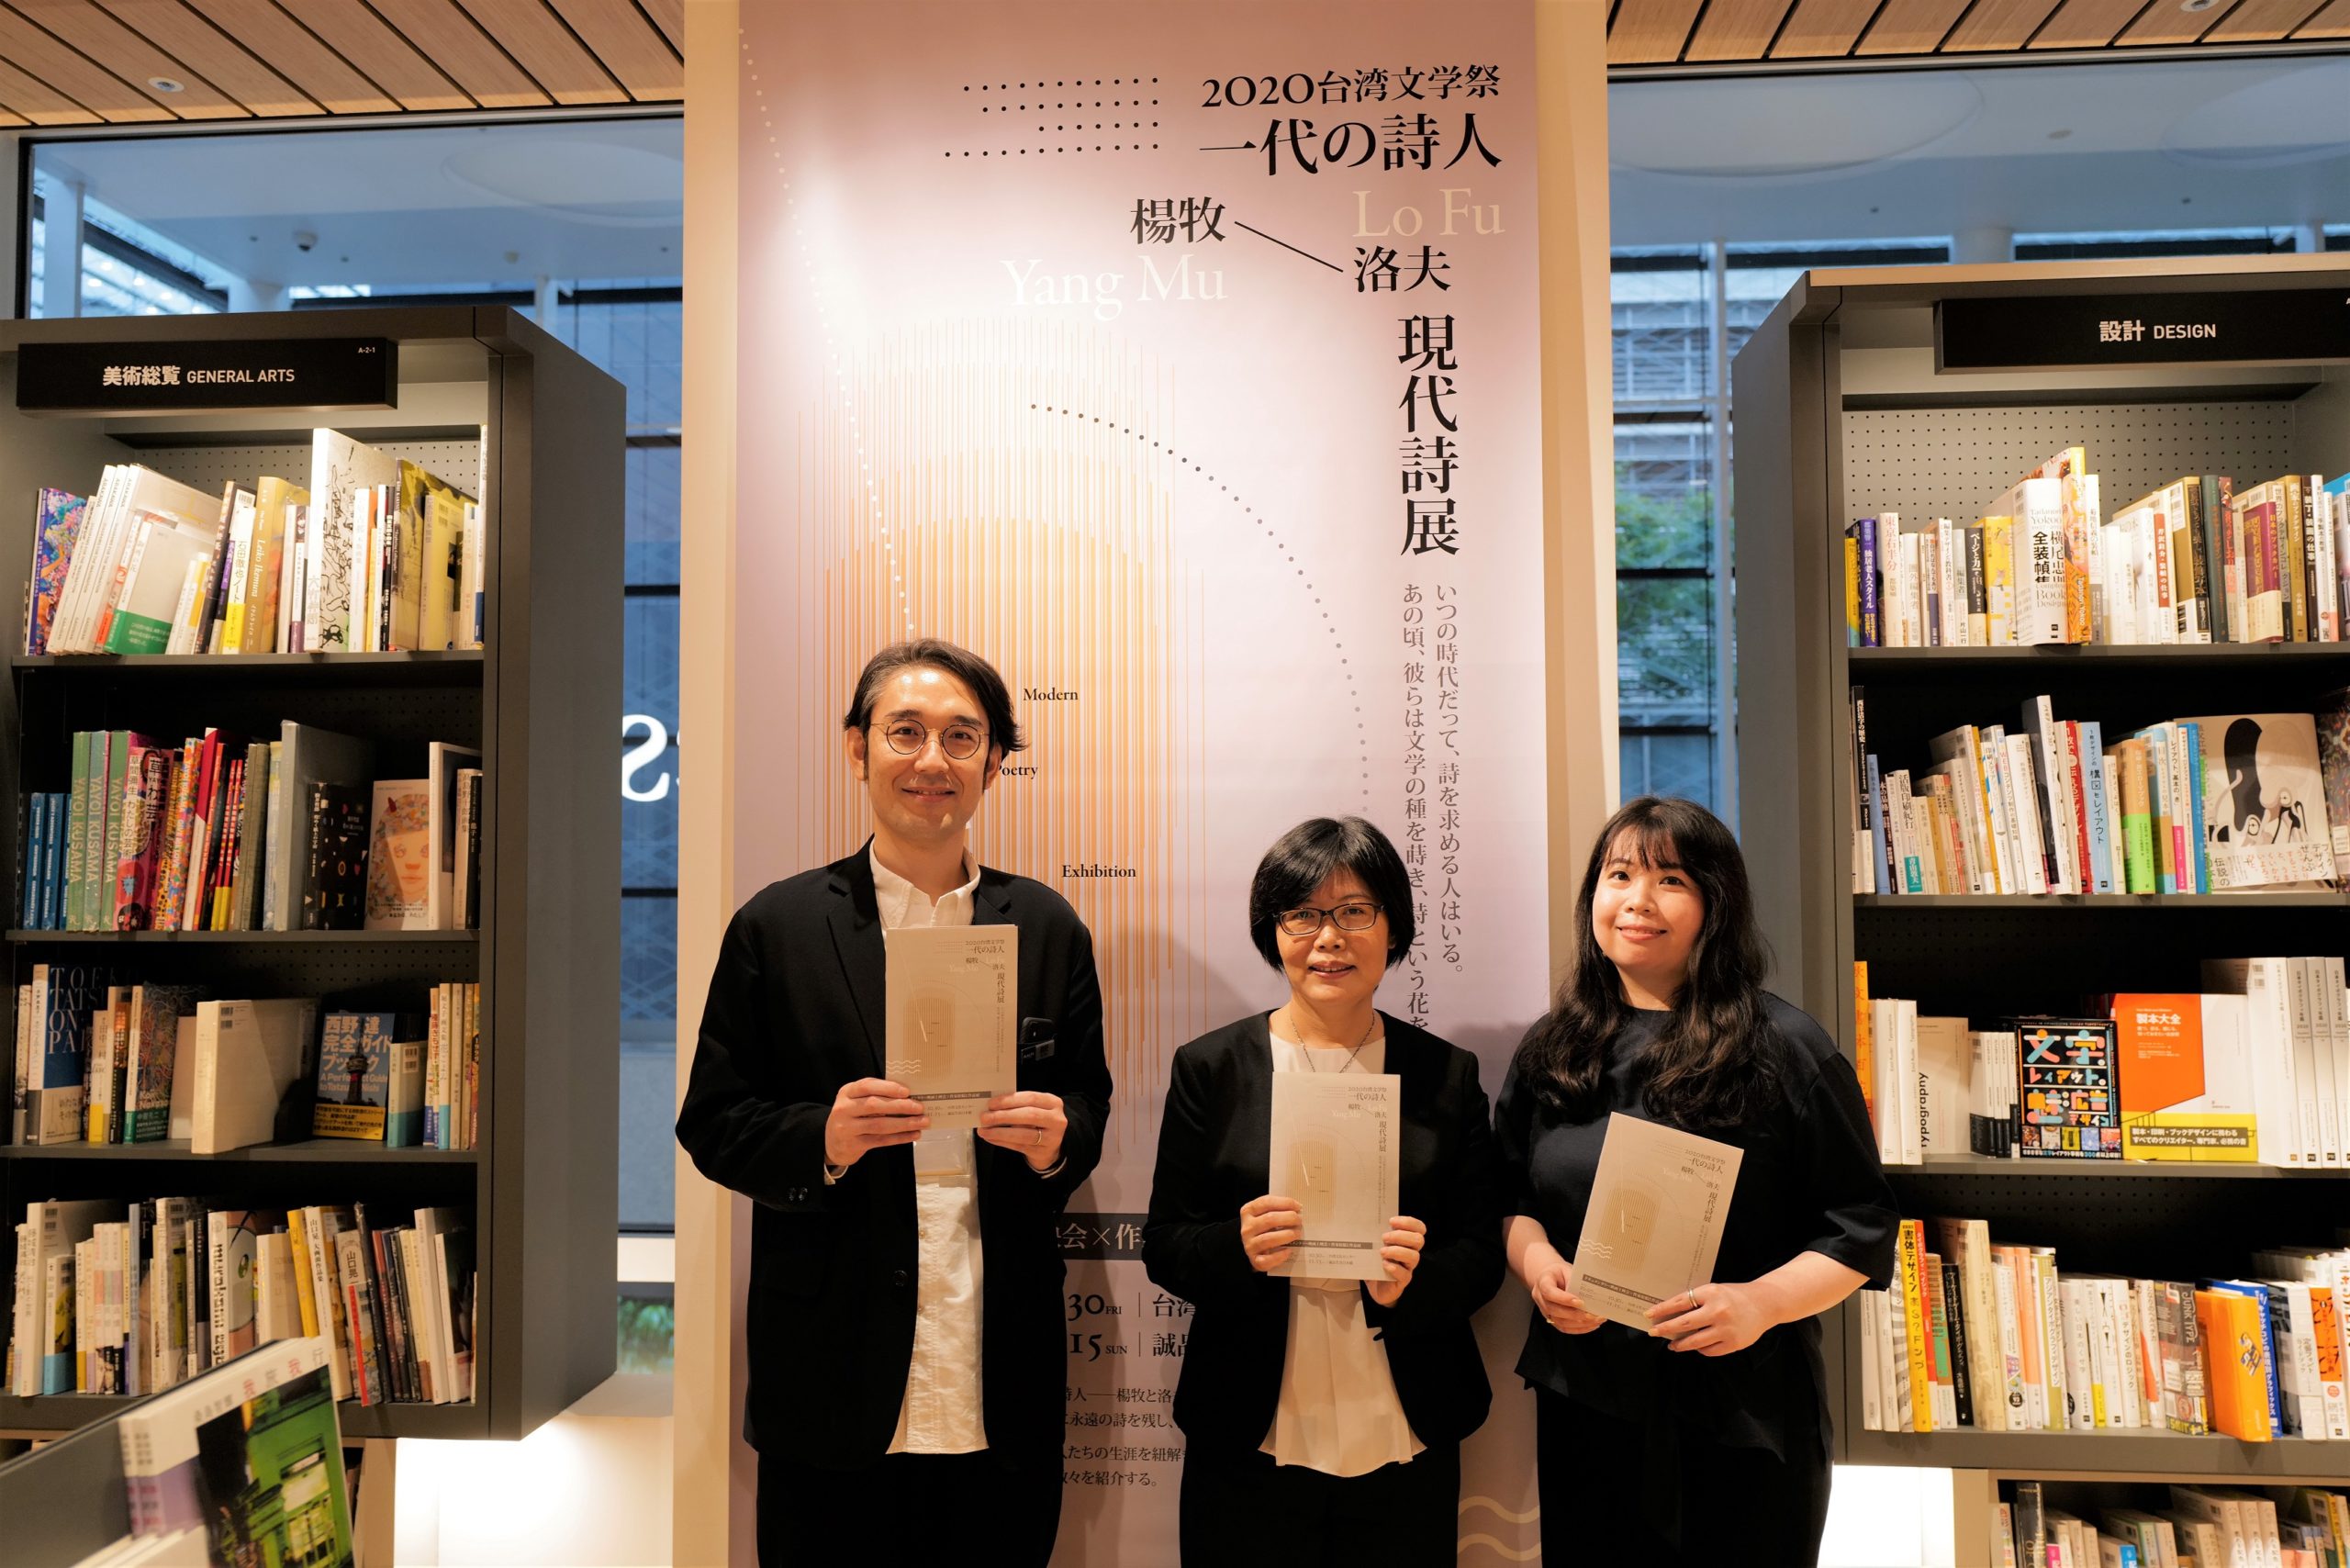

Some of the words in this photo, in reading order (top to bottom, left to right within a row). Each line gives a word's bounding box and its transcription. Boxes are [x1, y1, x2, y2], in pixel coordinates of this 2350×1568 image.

[1201, 64, 1500, 106] 2020台湾文学祭
[1200, 112, 1502, 175] 一代の詩人
[1130, 196, 1225, 244] 楊牧
[1352, 190, 1422, 238] Lo
[1438, 188, 1505, 235] Fu
[1001, 259, 1124, 320] Yang
[1136, 253, 1227, 301] Mu
[1354, 246, 1451, 293] 洛夫
[2098, 320, 2145, 342] 設計
[2153, 323, 2216, 339] DESIGN
[102, 366, 181, 387] 美術総覧
[186, 369, 254, 384] GENERAL
[257, 368, 295, 383] ARTS
[1398, 314, 1460, 555] 現代詩展
[1024, 688, 1079, 700] Modern
[998, 765, 1038, 779] oetry
[1437, 584, 1462, 972] いつの時代だって、詩を求める人はいる。
[72, 777, 86, 816] YAYOI
[89, 776, 104, 815] YAYOI
[109, 778, 124, 816] YAYOI
[70, 822, 85, 883] KUSAMA
[86, 822, 102, 882] KUSAMA
[105, 822, 120, 883] KUSAMA
[1062, 864, 1136, 878] Exhibition
[1068, 1294, 1104, 1322] 30
[1106, 1305, 1122, 1315] FRI
[1069, 1333, 1102, 1362] 15
[1105, 1345, 1127, 1355] SUN
